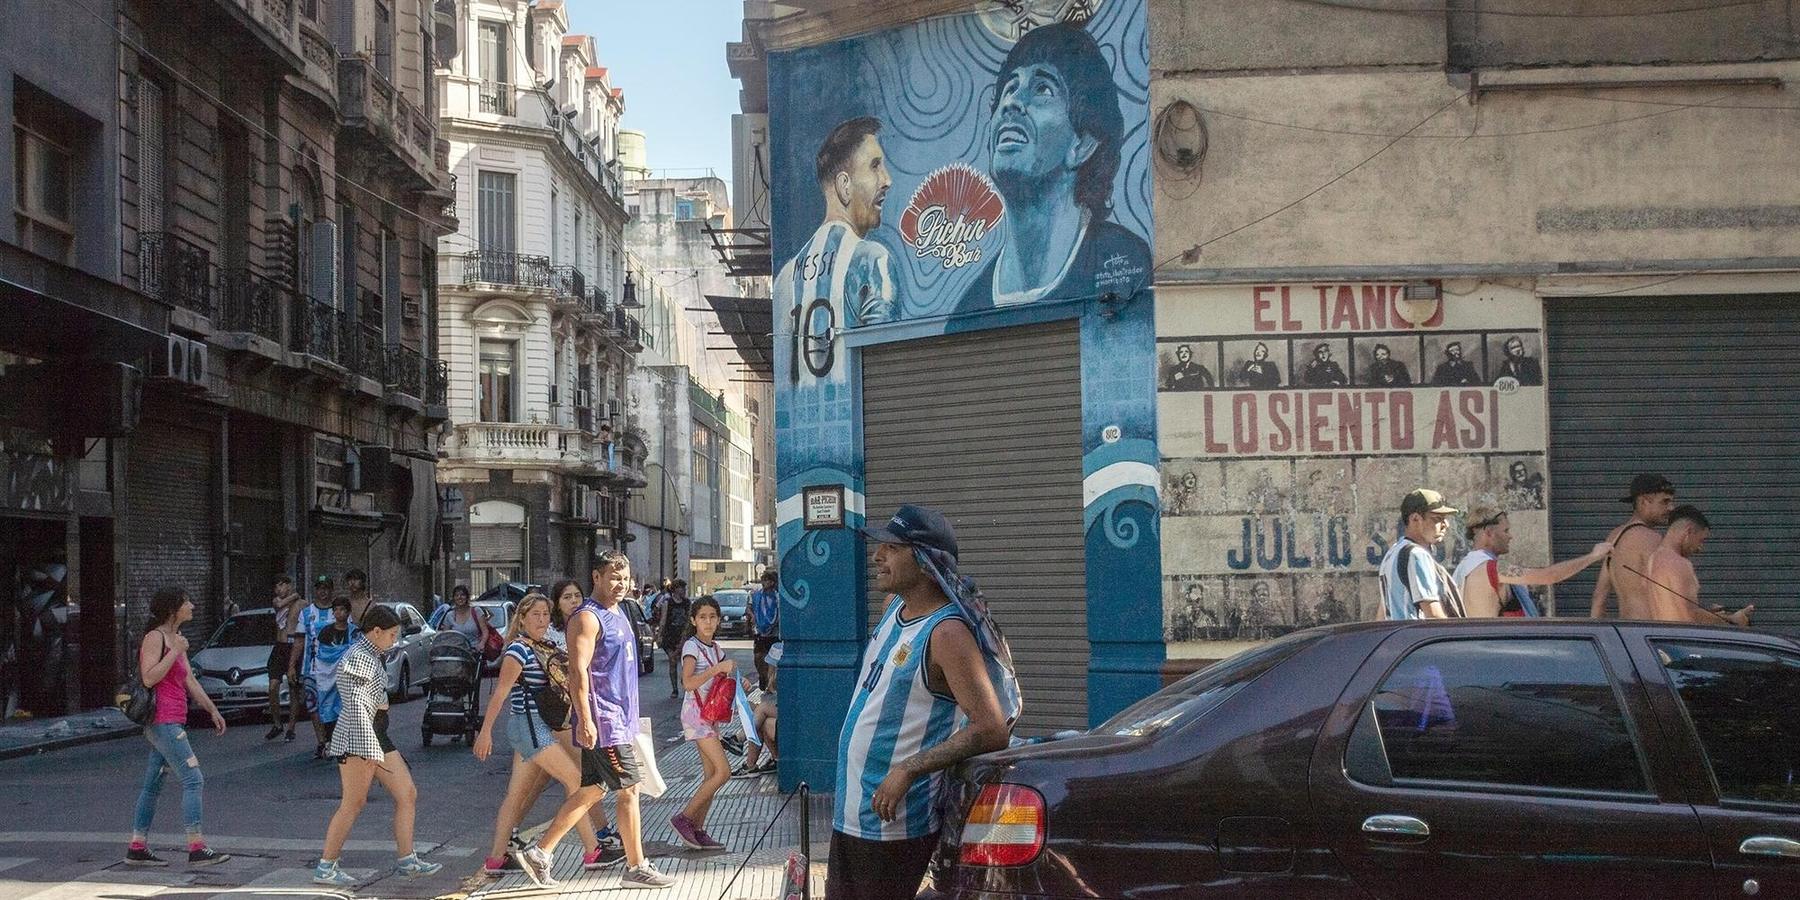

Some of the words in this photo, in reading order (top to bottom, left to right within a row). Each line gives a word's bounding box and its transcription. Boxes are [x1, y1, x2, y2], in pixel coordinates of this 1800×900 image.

[915, 204, 986, 249] Pichin
[792, 250, 835, 281] MESSI
[930, 242, 982, 269] Bar
[1253, 285, 1303, 332] EL
[790, 297, 836, 386] 10
[1203, 392, 1259, 454] LO
[1267, 390, 1415, 452] SIENTO
[1431, 389, 1500, 450] ASI
[1226, 515, 1353, 571] JULIO
[862, 659, 884, 693] 10
